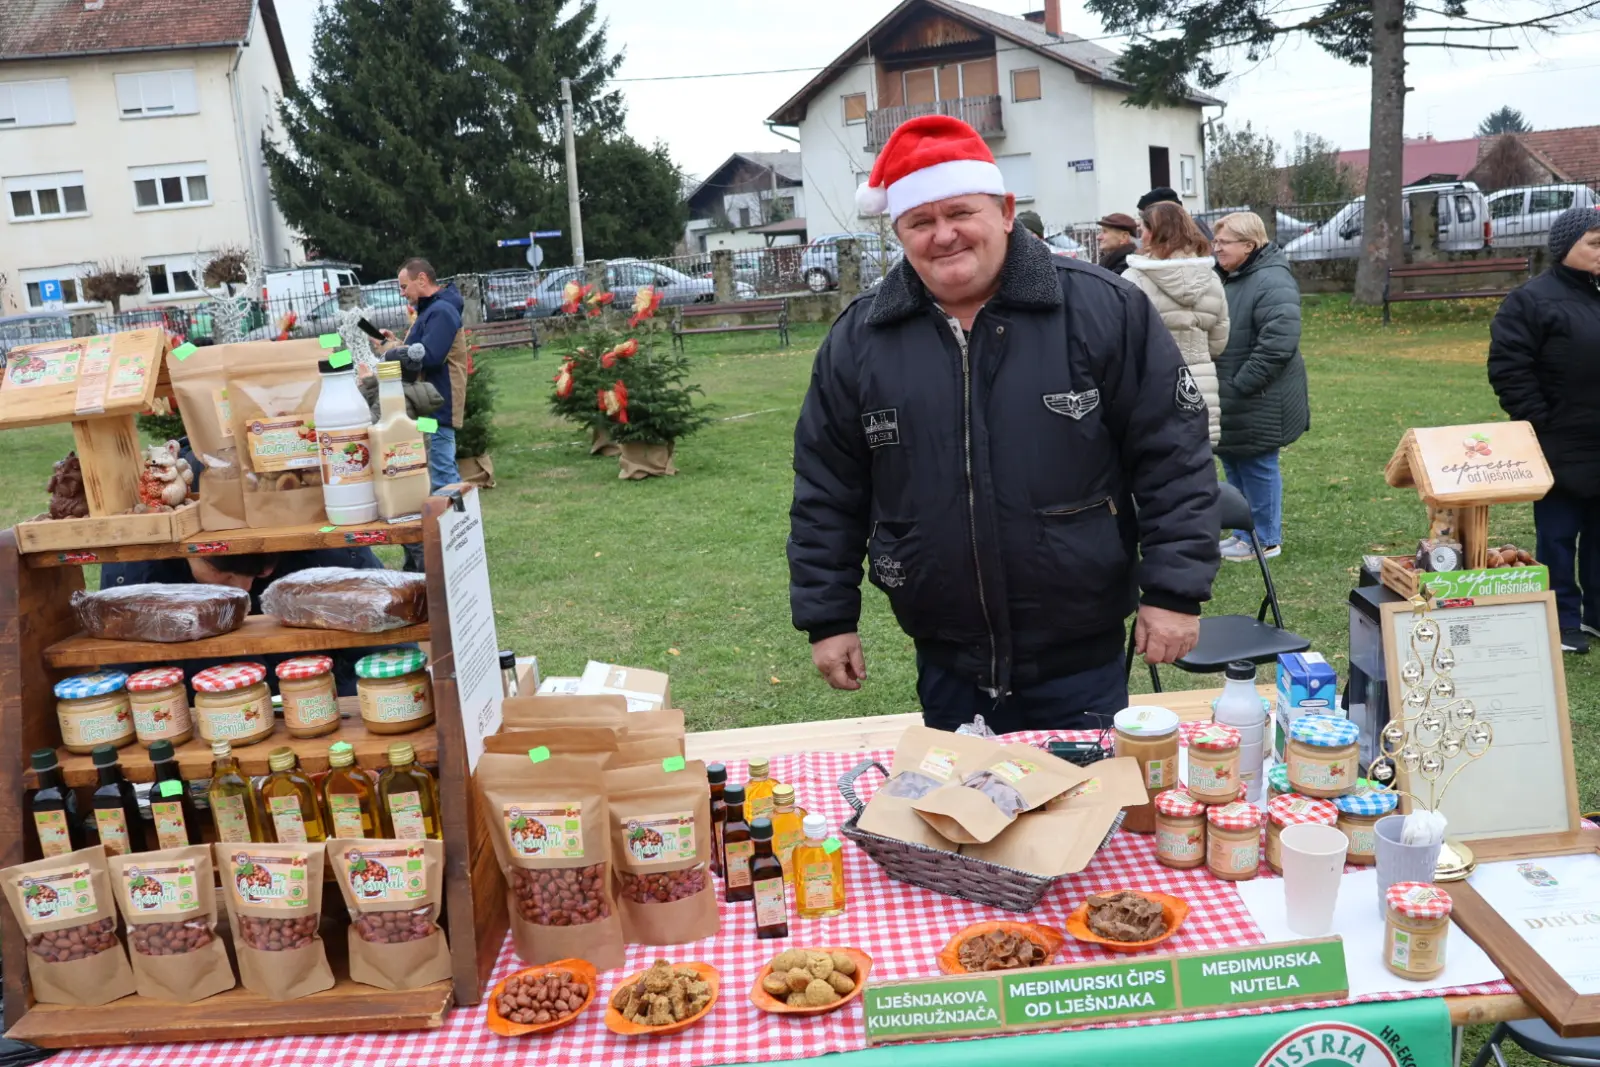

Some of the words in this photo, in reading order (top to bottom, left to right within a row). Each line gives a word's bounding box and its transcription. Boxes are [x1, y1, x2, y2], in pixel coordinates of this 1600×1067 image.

[45, 283, 55, 297] P
[1467, 470, 1480, 483] od
[1484, 466, 1533, 484] lješnjaka
[1479, 582, 1492, 595] od
[1202, 951, 1321, 978] MEĐIMURSKA
[1009, 973, 1123, 998] MEĐIMURSKI
[1127, 966, 1166, 986] ČIPS
[1230, 975, 1300, 995] NUTELA
[876, 988, 988, 1010] LJEŠNJAKOVA
[1025, 1001, 1052, 1018] OD
[1056, 991, 1155, 1015] LJEŠNJAKA
[868, 1006, 998, 1029] KUKURUŽNJAČA
